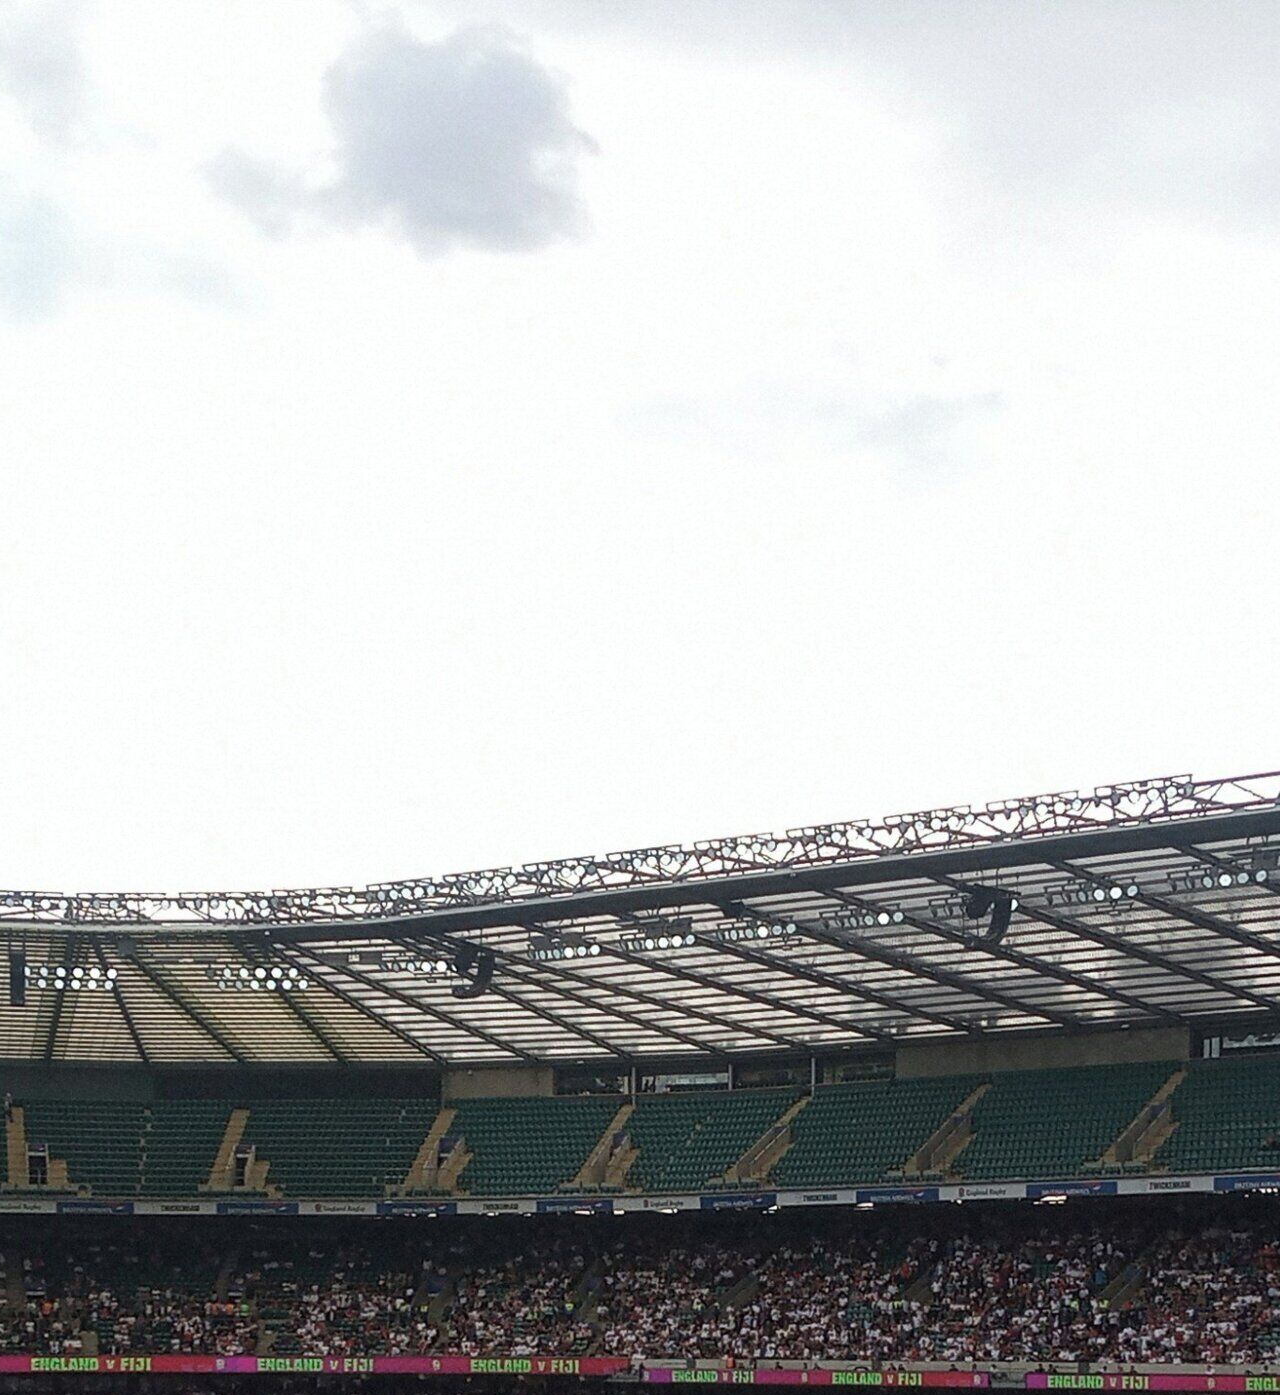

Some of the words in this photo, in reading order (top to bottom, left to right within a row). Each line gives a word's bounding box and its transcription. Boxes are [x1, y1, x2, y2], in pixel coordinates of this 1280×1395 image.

[31, 1358, 99, 1372] ENGLAND
[120, 1358, 152, 1372] FIJI
[257, 1358, 323, 1372] ENGLAND
[344, 1358, 374, 1372] FIJI
[551, 1359, 580, 1373] FIJI
[832, 1372, 882, 1385] ENGLAND
[898, 1373, 922, 1385] FIJI
[1047, 1375, 1104, 1388] ENGLAND
[1122, 1377, 1149, 1389] FIJI
